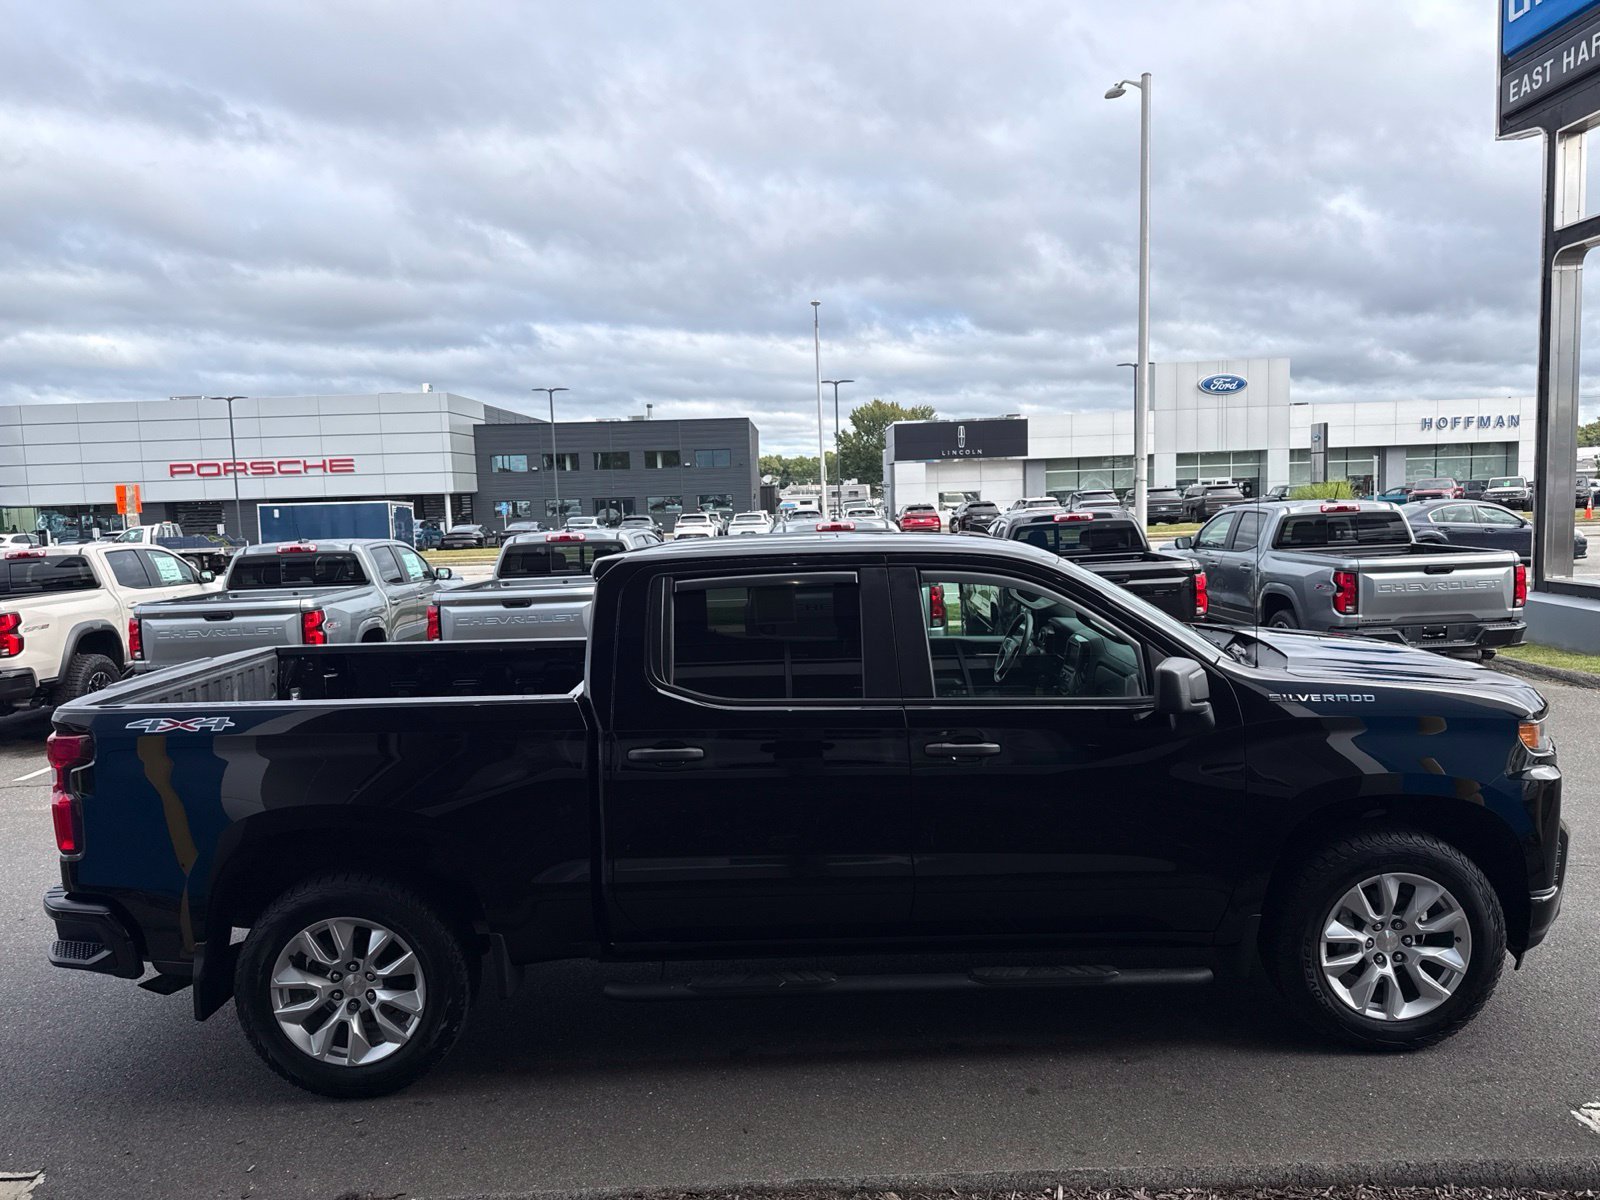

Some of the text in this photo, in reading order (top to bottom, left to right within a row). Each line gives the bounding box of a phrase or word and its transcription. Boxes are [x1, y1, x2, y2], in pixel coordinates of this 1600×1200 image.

[1509, 58, 1554, 103] EAST
[1421, 414, 1520, 431] HOFFMAN
[169, 458, 355, 478] PORSCHE
[1377, 580, 1501, 593] CHEVROLET
[456, 613, 581, 626] CHEVROLET
[157, 626, 283, 639] CHEVROLET
[1268, 693, 1376, 703] SILVERADO
